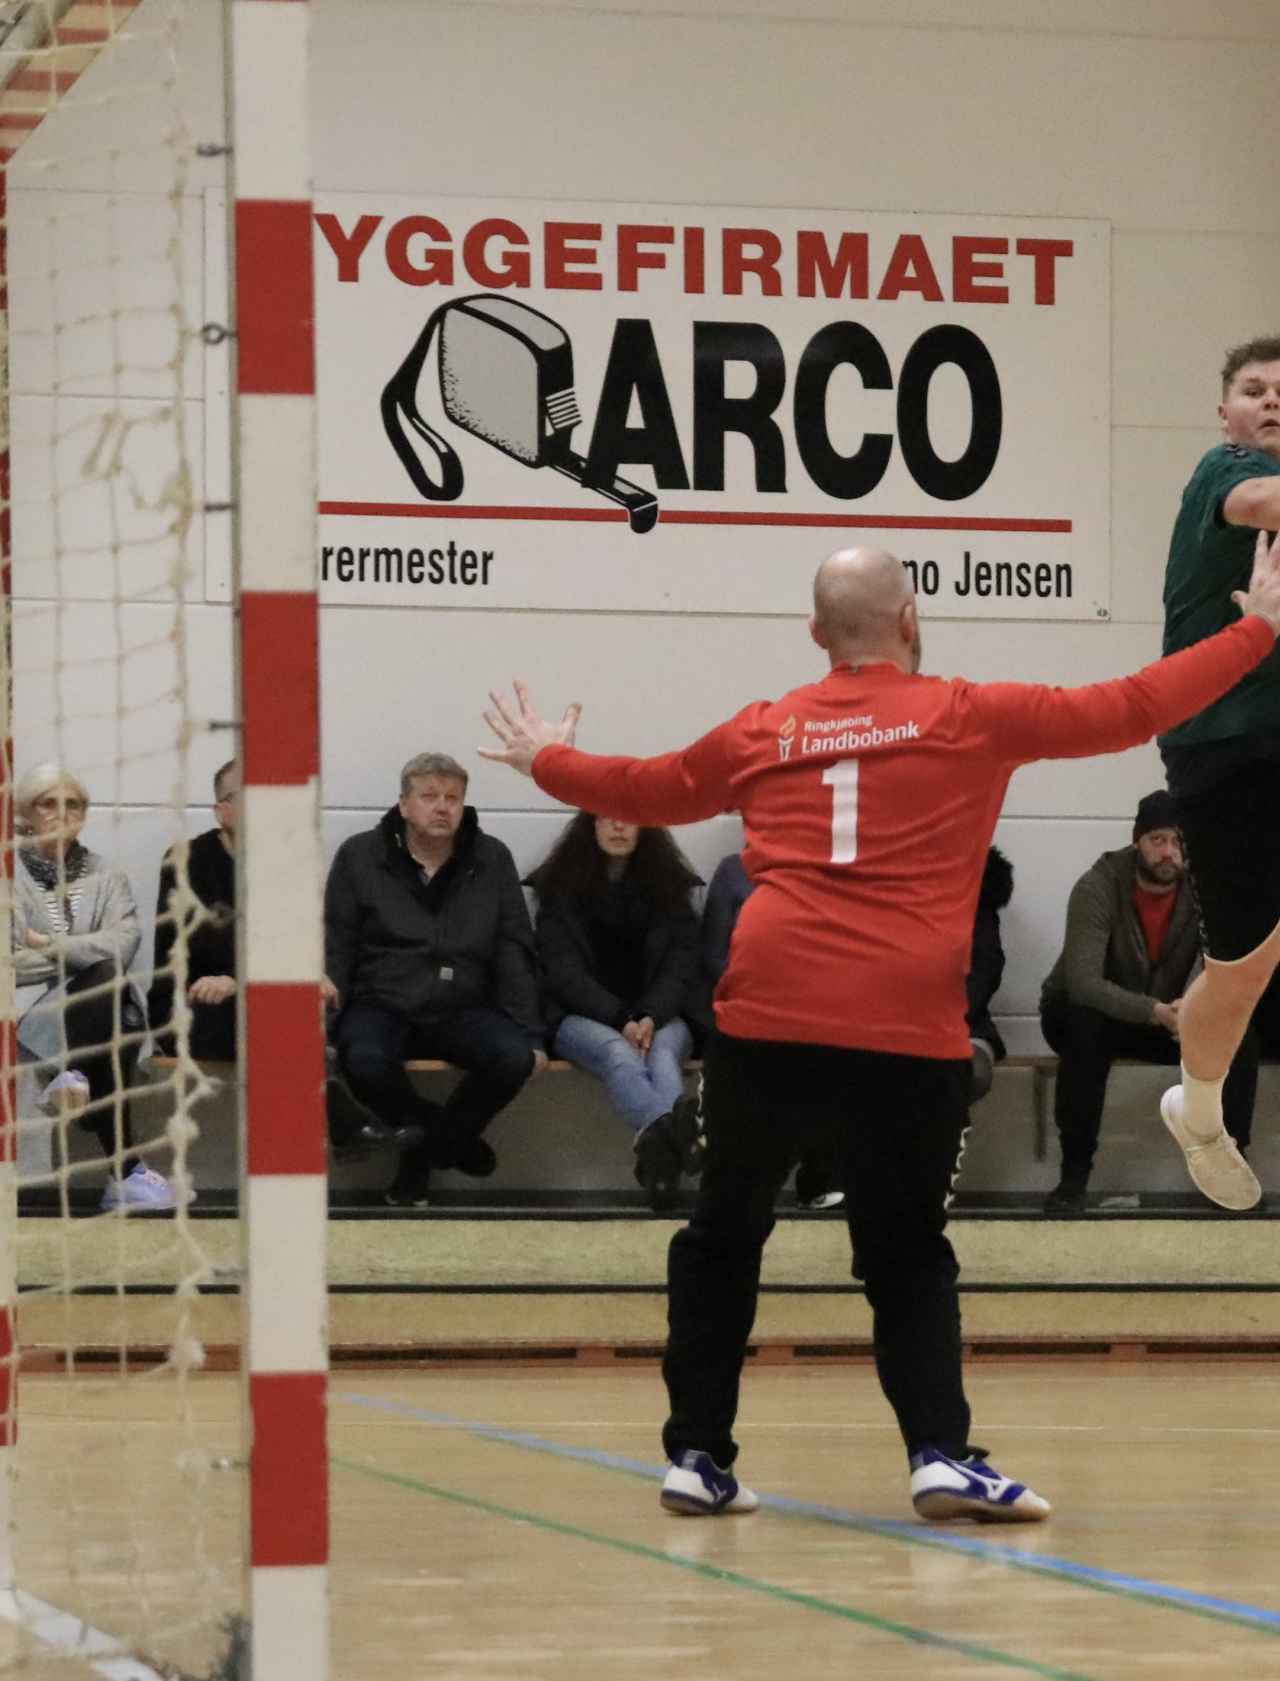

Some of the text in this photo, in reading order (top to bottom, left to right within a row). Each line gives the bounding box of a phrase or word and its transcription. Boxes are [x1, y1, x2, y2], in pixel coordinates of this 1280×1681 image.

[580, 317, 1003, 501] ARCO
[954, 550, 1073, 598] Jensen
[801, 720, 920, 754] Landbobank
[821, 758, 859, 864] 1
